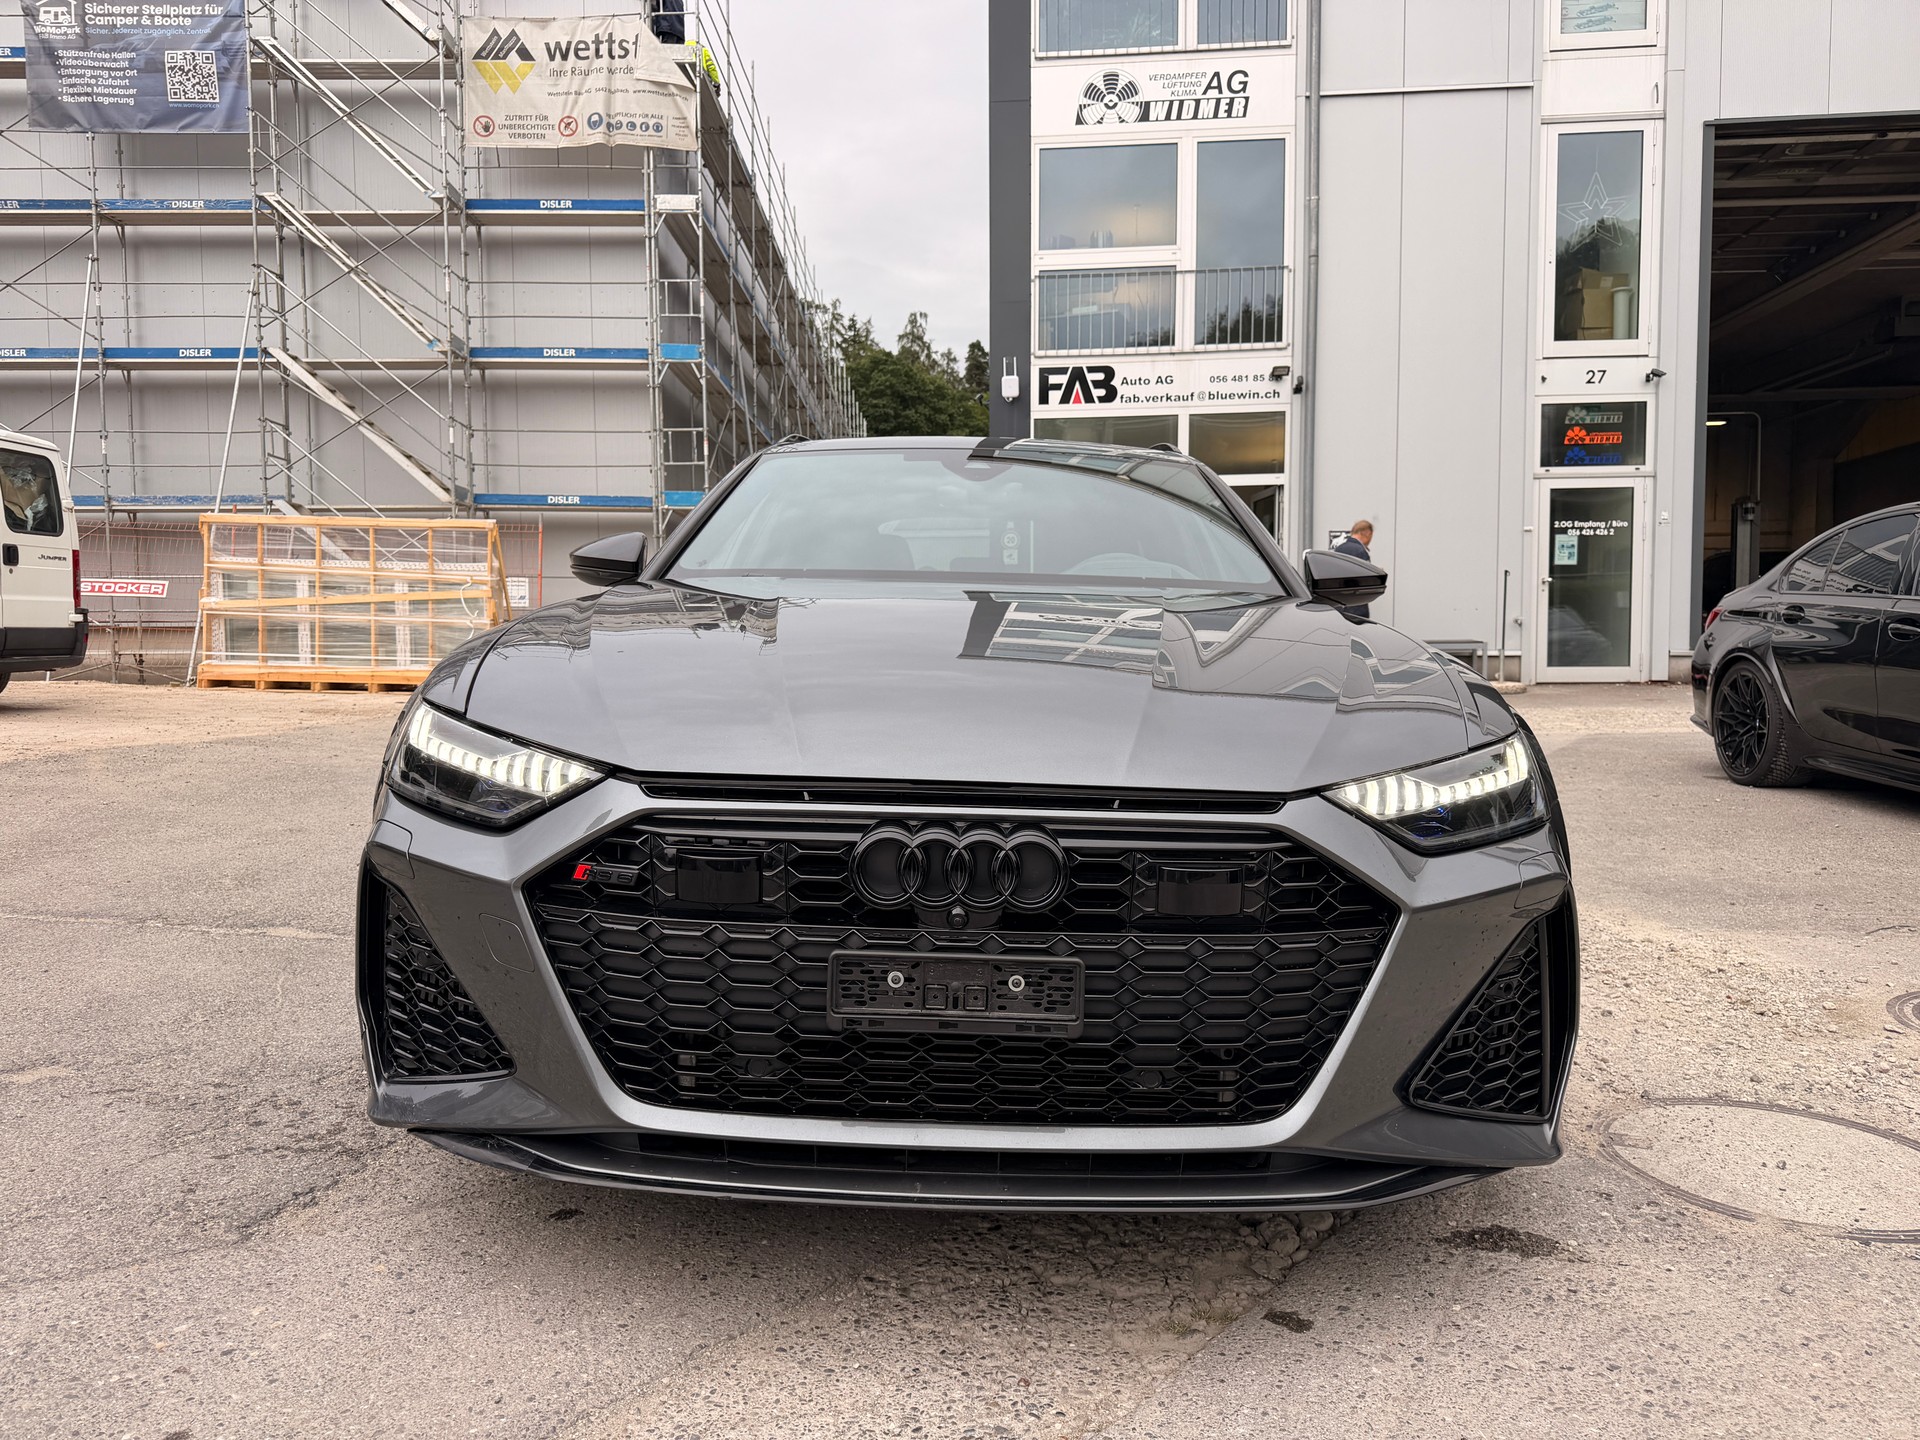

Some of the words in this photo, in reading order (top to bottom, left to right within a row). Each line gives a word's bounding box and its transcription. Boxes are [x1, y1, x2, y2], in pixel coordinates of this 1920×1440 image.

[84, 3, 139, 14] Sicherer
[142, 5, 202, 17] Stellplatz
[204, 4, 224, 15] für
[84, 15, 138, 27] Camper
[141, 16, 151, 25] &
[154, 16, 192, 26] Boote
[33, 25, 81, 34] WoMoPark
[111, 51, 136, 59] Hallen
[59, 58, 129, 68] Videoüberwacht
[61, 68, 109, 78] Entsorgung
[125, 69, 138, 77] Ort
[549, 68, 568, 78] Ihre
[570, 66, 604, 77] Räume
[1148, 72, 1207, 81] VERDAMPFER
[62, 77, 96, 85] Einfache
[97, 78, 129, 86] Zufahrt
[1162, 80, 1202, 89] LÜFTUNG
[1201, 69, 1249, 96] AG
[63, 86, 92, 94] Flexible
[93, 87, 137, 95] Mietdauer
[1170, 89, 1197, 97] KLIMA
[62, 95, 92, 103] Sichere
[93, 95, 135, 105] Lagerung
[1150, 97, 1246, 121] WIDMER
[534, 114, 549, 122] FÜR
[650, 113, 664, 121] ALLE
[497, 123, 556, 131] UNBERECHTIGTE
[508, 132, 546, 140] VERBOTEN
[171, 200, 205, 209] DISLER
[539, 200, 572, 209] DISLER
[0, 349, 27, 357] ISLER
[179, 349, 212, 357] DISLER
[543, 348, 576, 357] DISLER
[1120, 376, 1150, 386] Auto
[1154, 375, 1174, 385] AG
[1209, 375, 1228, 384] 056
[1231, 374, 1249, 383] 481
[1252, 374, 1265, 382] 85
[1585, 369, 1607, 384] 27
[1038, 365, 1118, 405] FAB
[1119, 389, 1281, 404] fab.verkauf@bluewin.ch
[547, 495, 580, 504] DISLER
[1554, 520, 1573, 528] 2.OG
[1574, 520, 1606, 529] Empfang
[1567, 528, 1580, 536] 056
[1581, 528, 1594, 536] 426
[1595, 528, 1608, 536] 426
[38, 554, 67, 562] JUMPER
[80, 582, 163, 594] STOCKER
